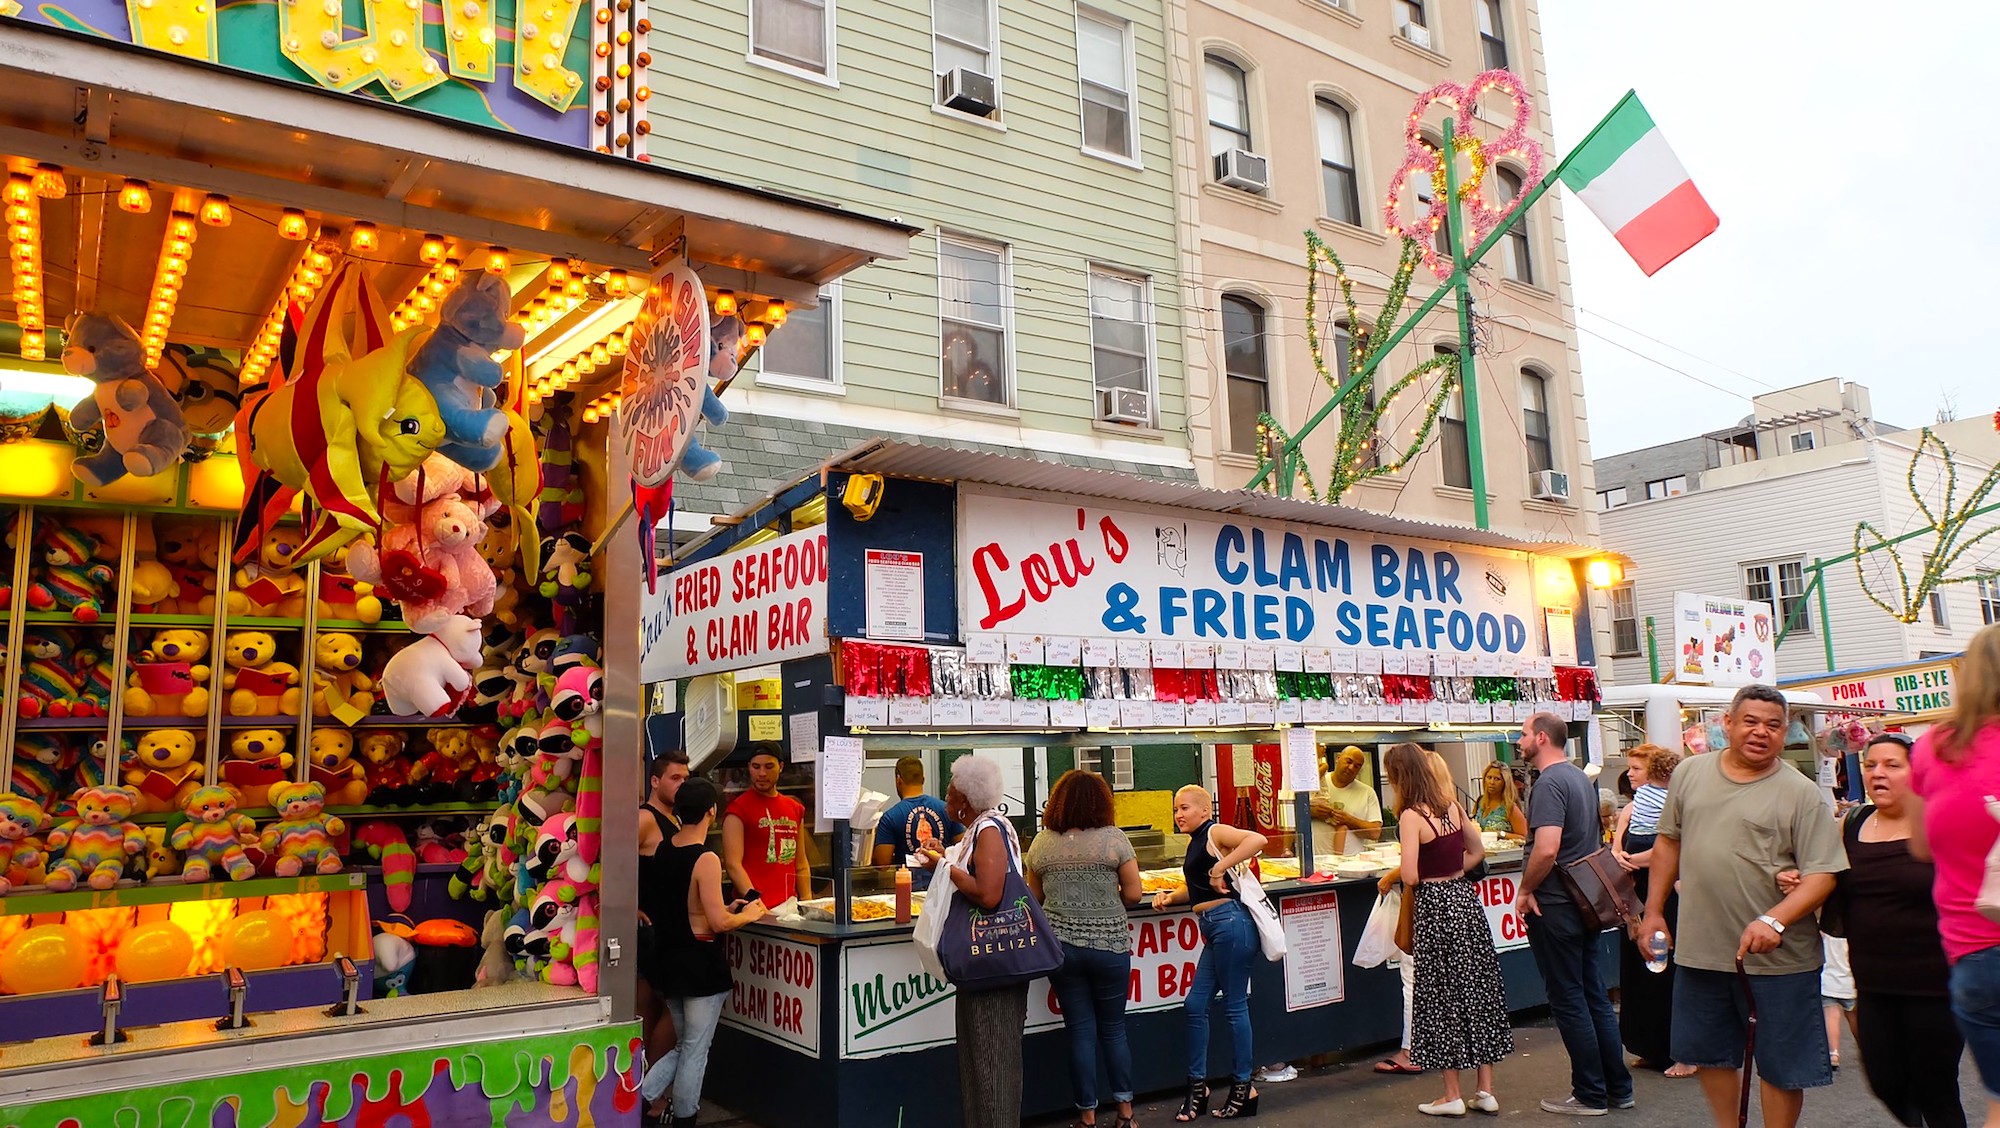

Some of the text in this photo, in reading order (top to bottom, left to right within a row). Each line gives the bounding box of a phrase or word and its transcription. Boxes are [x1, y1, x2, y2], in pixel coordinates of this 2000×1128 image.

[621, 272, 701, 401] WATER GUN
[633, 414, 678, 478] FUN
[675, 564, 721, 617] FRIED
[732, 534, 828, 605] SEAFOOD
[972, 508, 1129, 629] Lou's
[1215, 524, 1351, 595] CLAM
[1371, 543, 1463, 604] BAR
[687, 597, 813, 666] & CLAM BAR
[1101, 582, 1147, 634] &
[1159, 586, 1315, 642] FRIED
[1335, 600, 1526, 654] SEAFOOD
[1832, 682, 1867, 701] PORK
[1894, 670, 1949, 692] RIB-EYE
[1896, 691, 1951, 711] STEAKS
[1254, 759, 1275, 830] Coca-Cola
[92, 890, 120, 908] 14
[203, 883, 225, 899] 15
[298, 876, 320, 892] 16
[1502, 913, 1528, 941] CL
[749, 938, 814, 990] SEAFOOD
[1158, 961, 1197, 998] BA
[732, 980, 803, 1035] CLAM BAR
